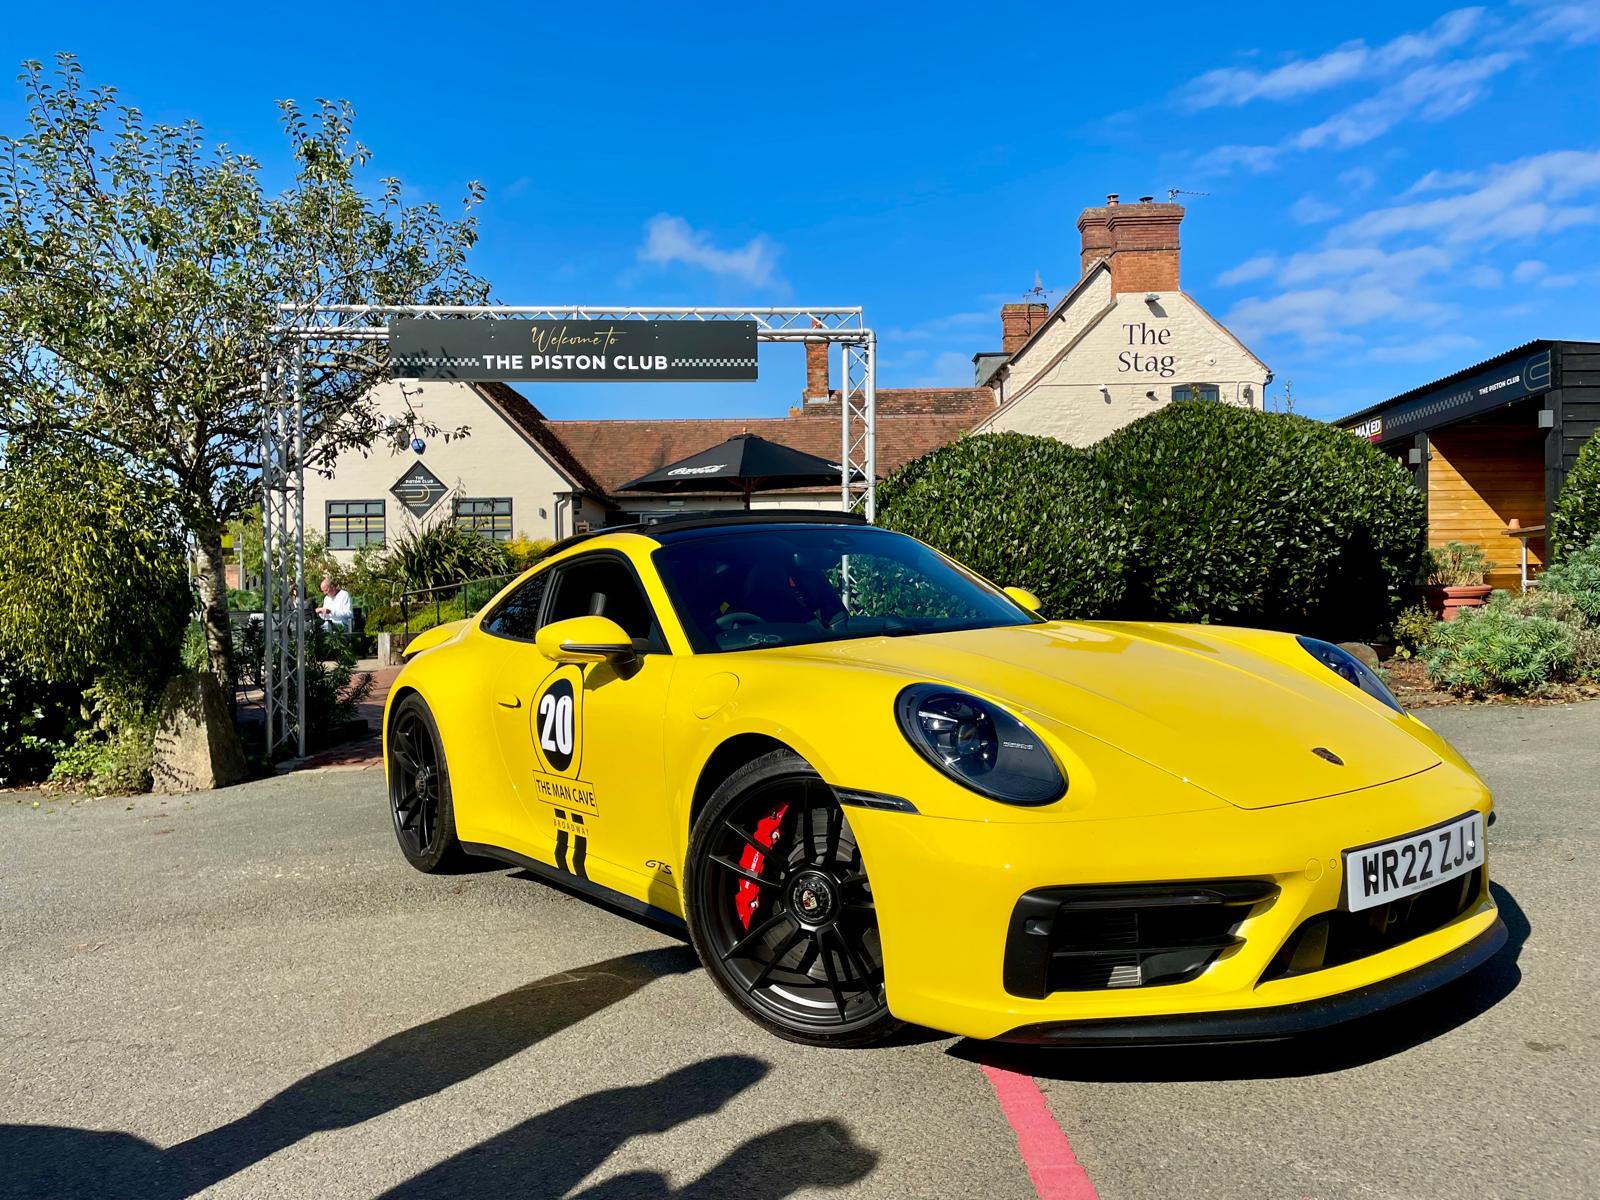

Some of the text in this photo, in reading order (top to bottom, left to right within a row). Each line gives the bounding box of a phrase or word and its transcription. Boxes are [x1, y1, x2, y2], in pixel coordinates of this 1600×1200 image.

[531, 325, 627, 354] Welcome to
[1122, 322, 1171, 345] The
[482, 354, 668, 370] THE PISTON CLUB
[1118, 351, 1176, 378] Stag
[1479, 375, 1520, 396] THE PISTON CLUB
[539, 693, 574, 756] 20
[535, 779, 596, 807] THE MAN CAVE
[553, 818, 590, 836] BROADWAY
[645, 859, 672, 875] GTS
[1361, 821, 1477, 897] WR22 ZJJ
